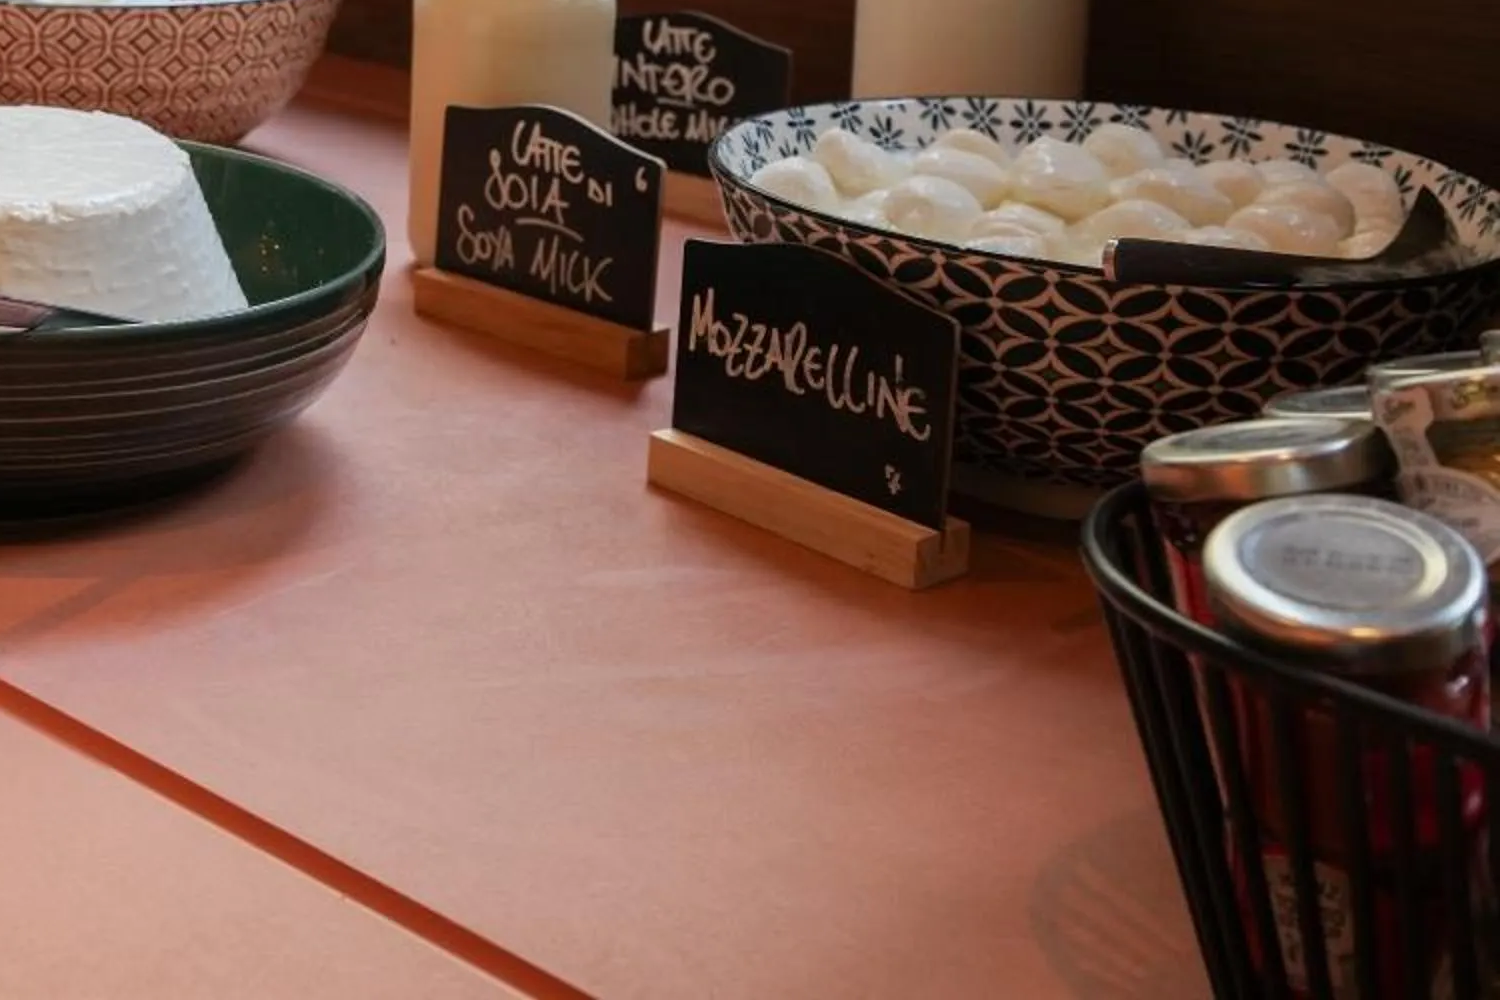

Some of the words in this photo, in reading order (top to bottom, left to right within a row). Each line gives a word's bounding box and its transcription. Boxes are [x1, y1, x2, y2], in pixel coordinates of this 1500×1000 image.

[642, 18, 716, 63] LATTE
[484, 149, 570, 225] SOIA
[511, 120, 584, 183] LATTE
[587, 178, 613, 207] DI
[456, 204, 514, 271] SOYA
[688, 287, 931, 441] MOZZARELLINE
